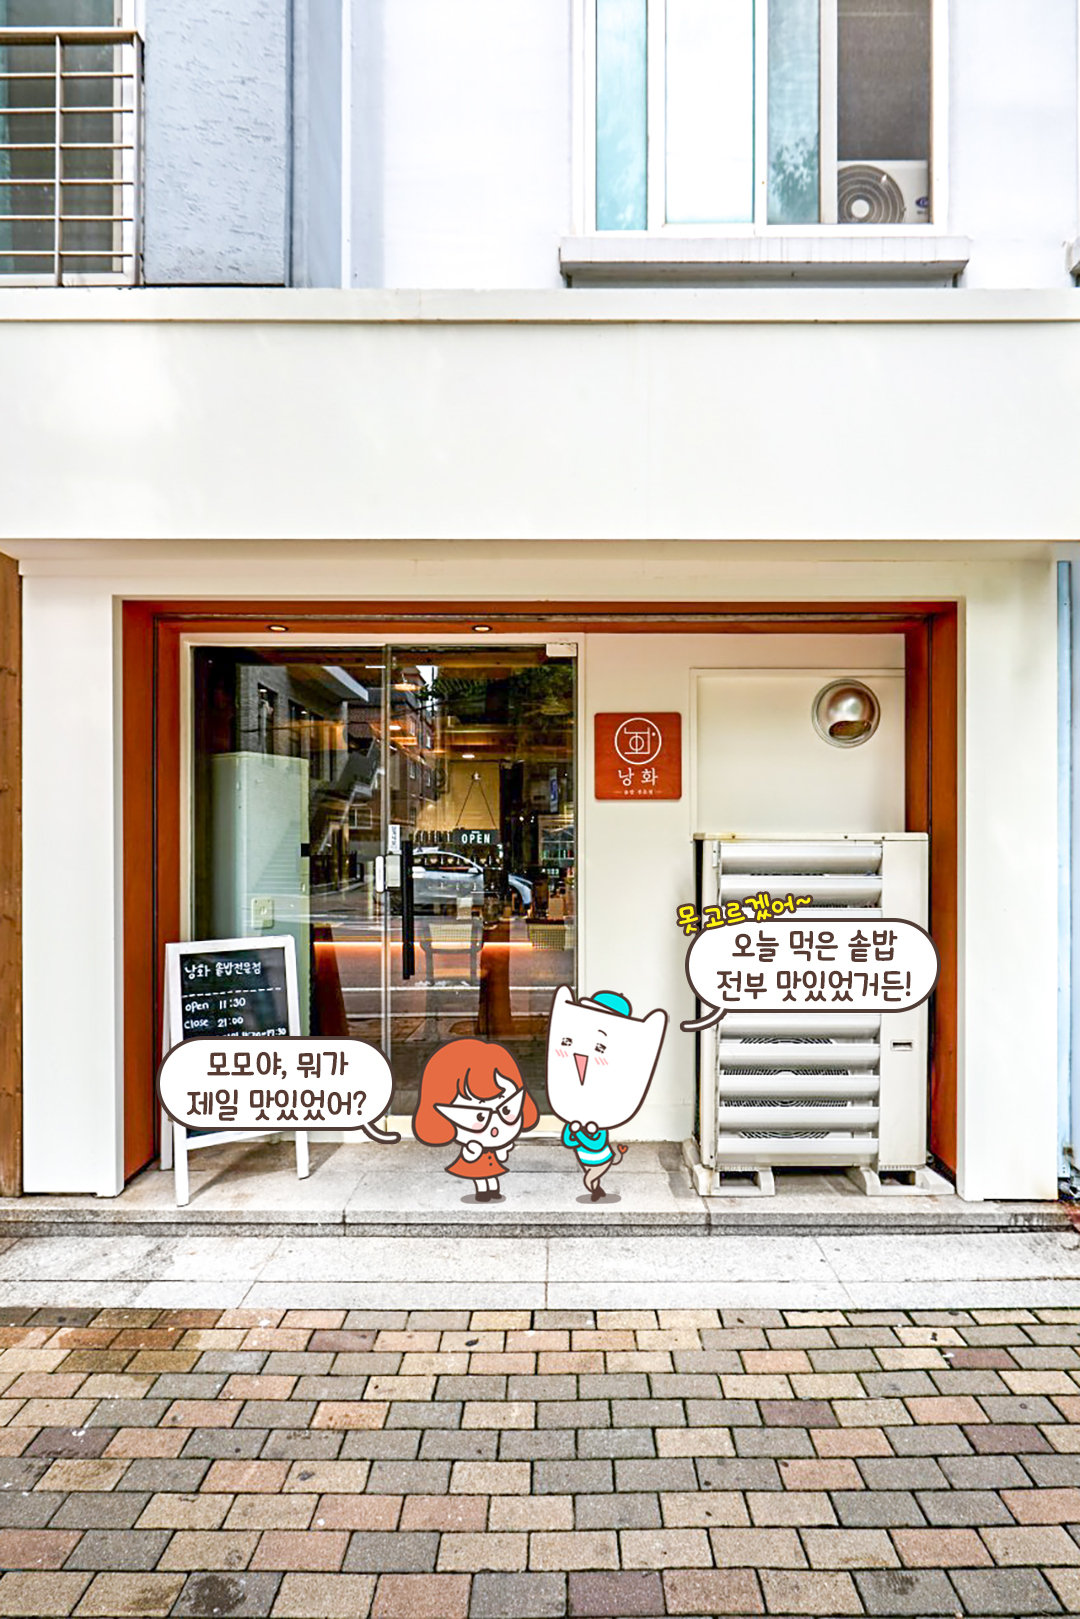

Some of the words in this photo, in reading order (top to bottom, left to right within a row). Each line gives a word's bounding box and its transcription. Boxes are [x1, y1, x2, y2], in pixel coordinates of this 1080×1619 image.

[461, 833, 491, 844] OPEN
[184, 963, 211, 980] 낭화
[219, 997, 246, 1010] 11:30
[217, 1016, 244, 1028] 21:00
